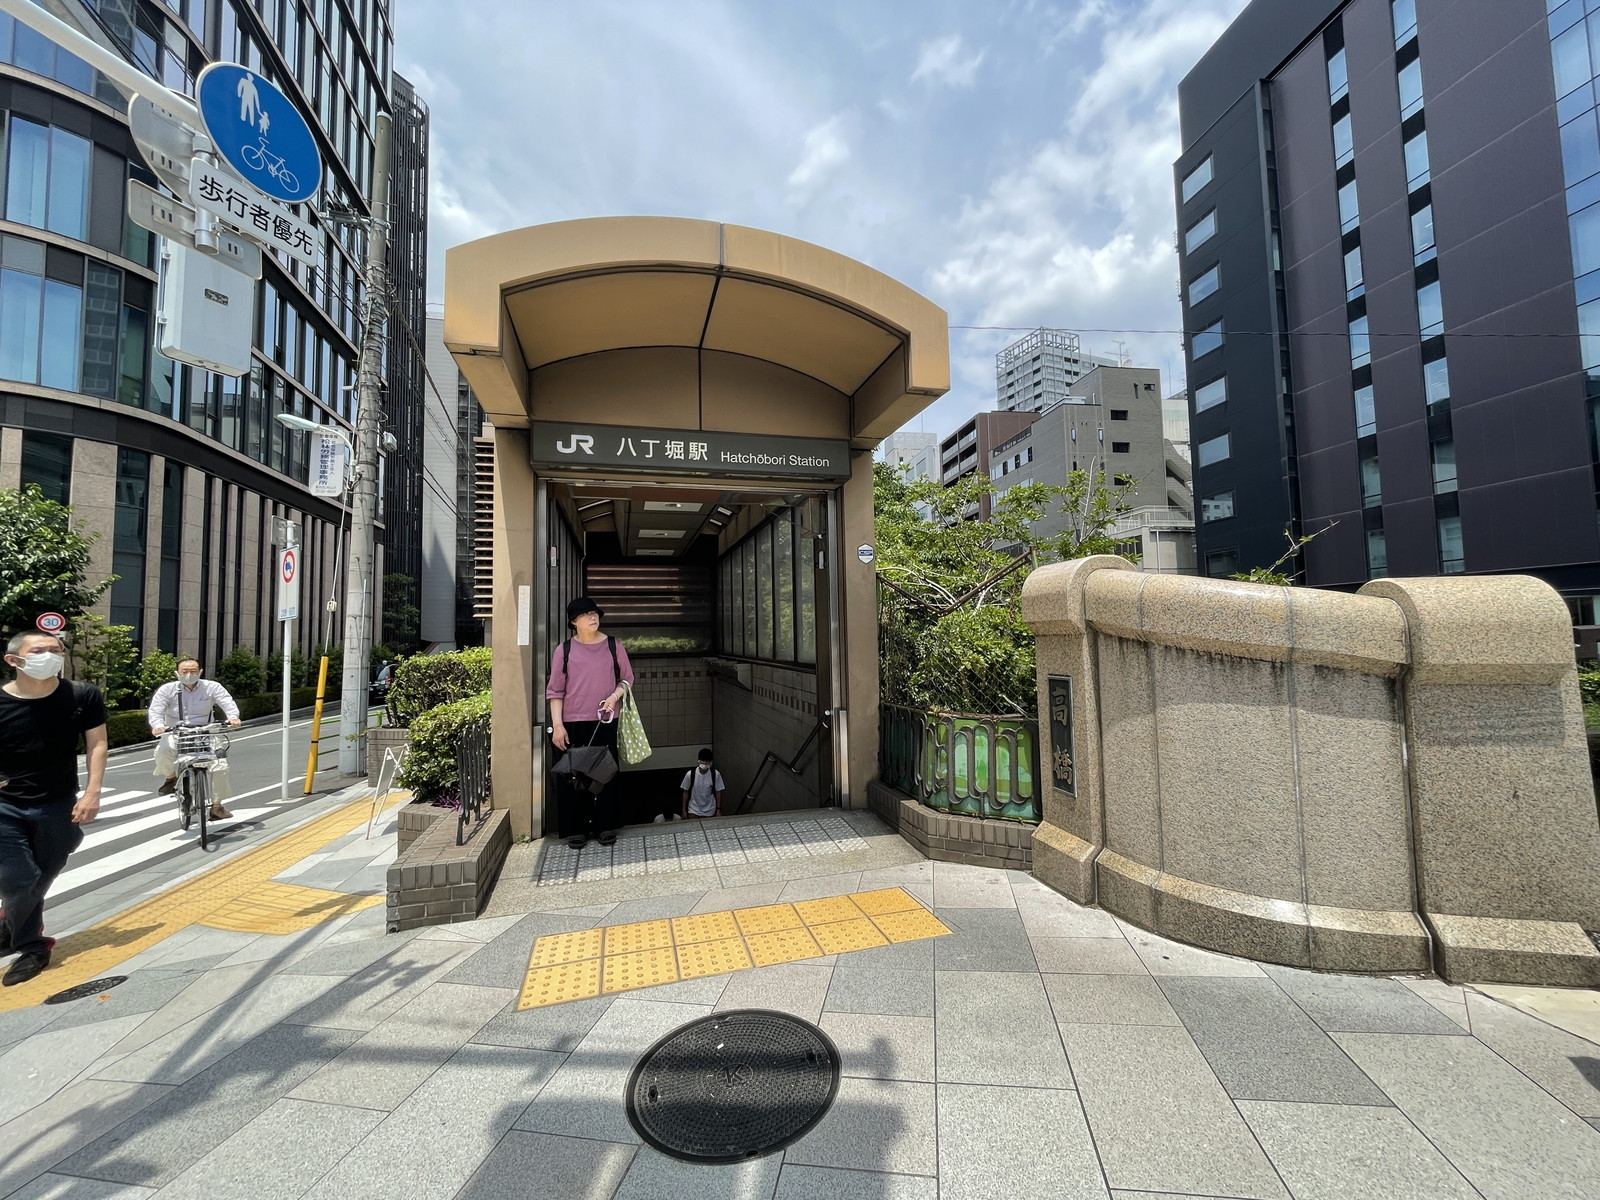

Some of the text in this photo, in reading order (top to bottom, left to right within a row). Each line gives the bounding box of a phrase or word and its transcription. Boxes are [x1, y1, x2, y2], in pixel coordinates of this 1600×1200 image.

[199, 175, 314, 256] 歩行者優先
[556, 434, 830, 467] JR 八丁堀駅 Hatchōbori Station
[43, 618, 59, 627] 30
[1051, 686, 1073, 785] 高橋
